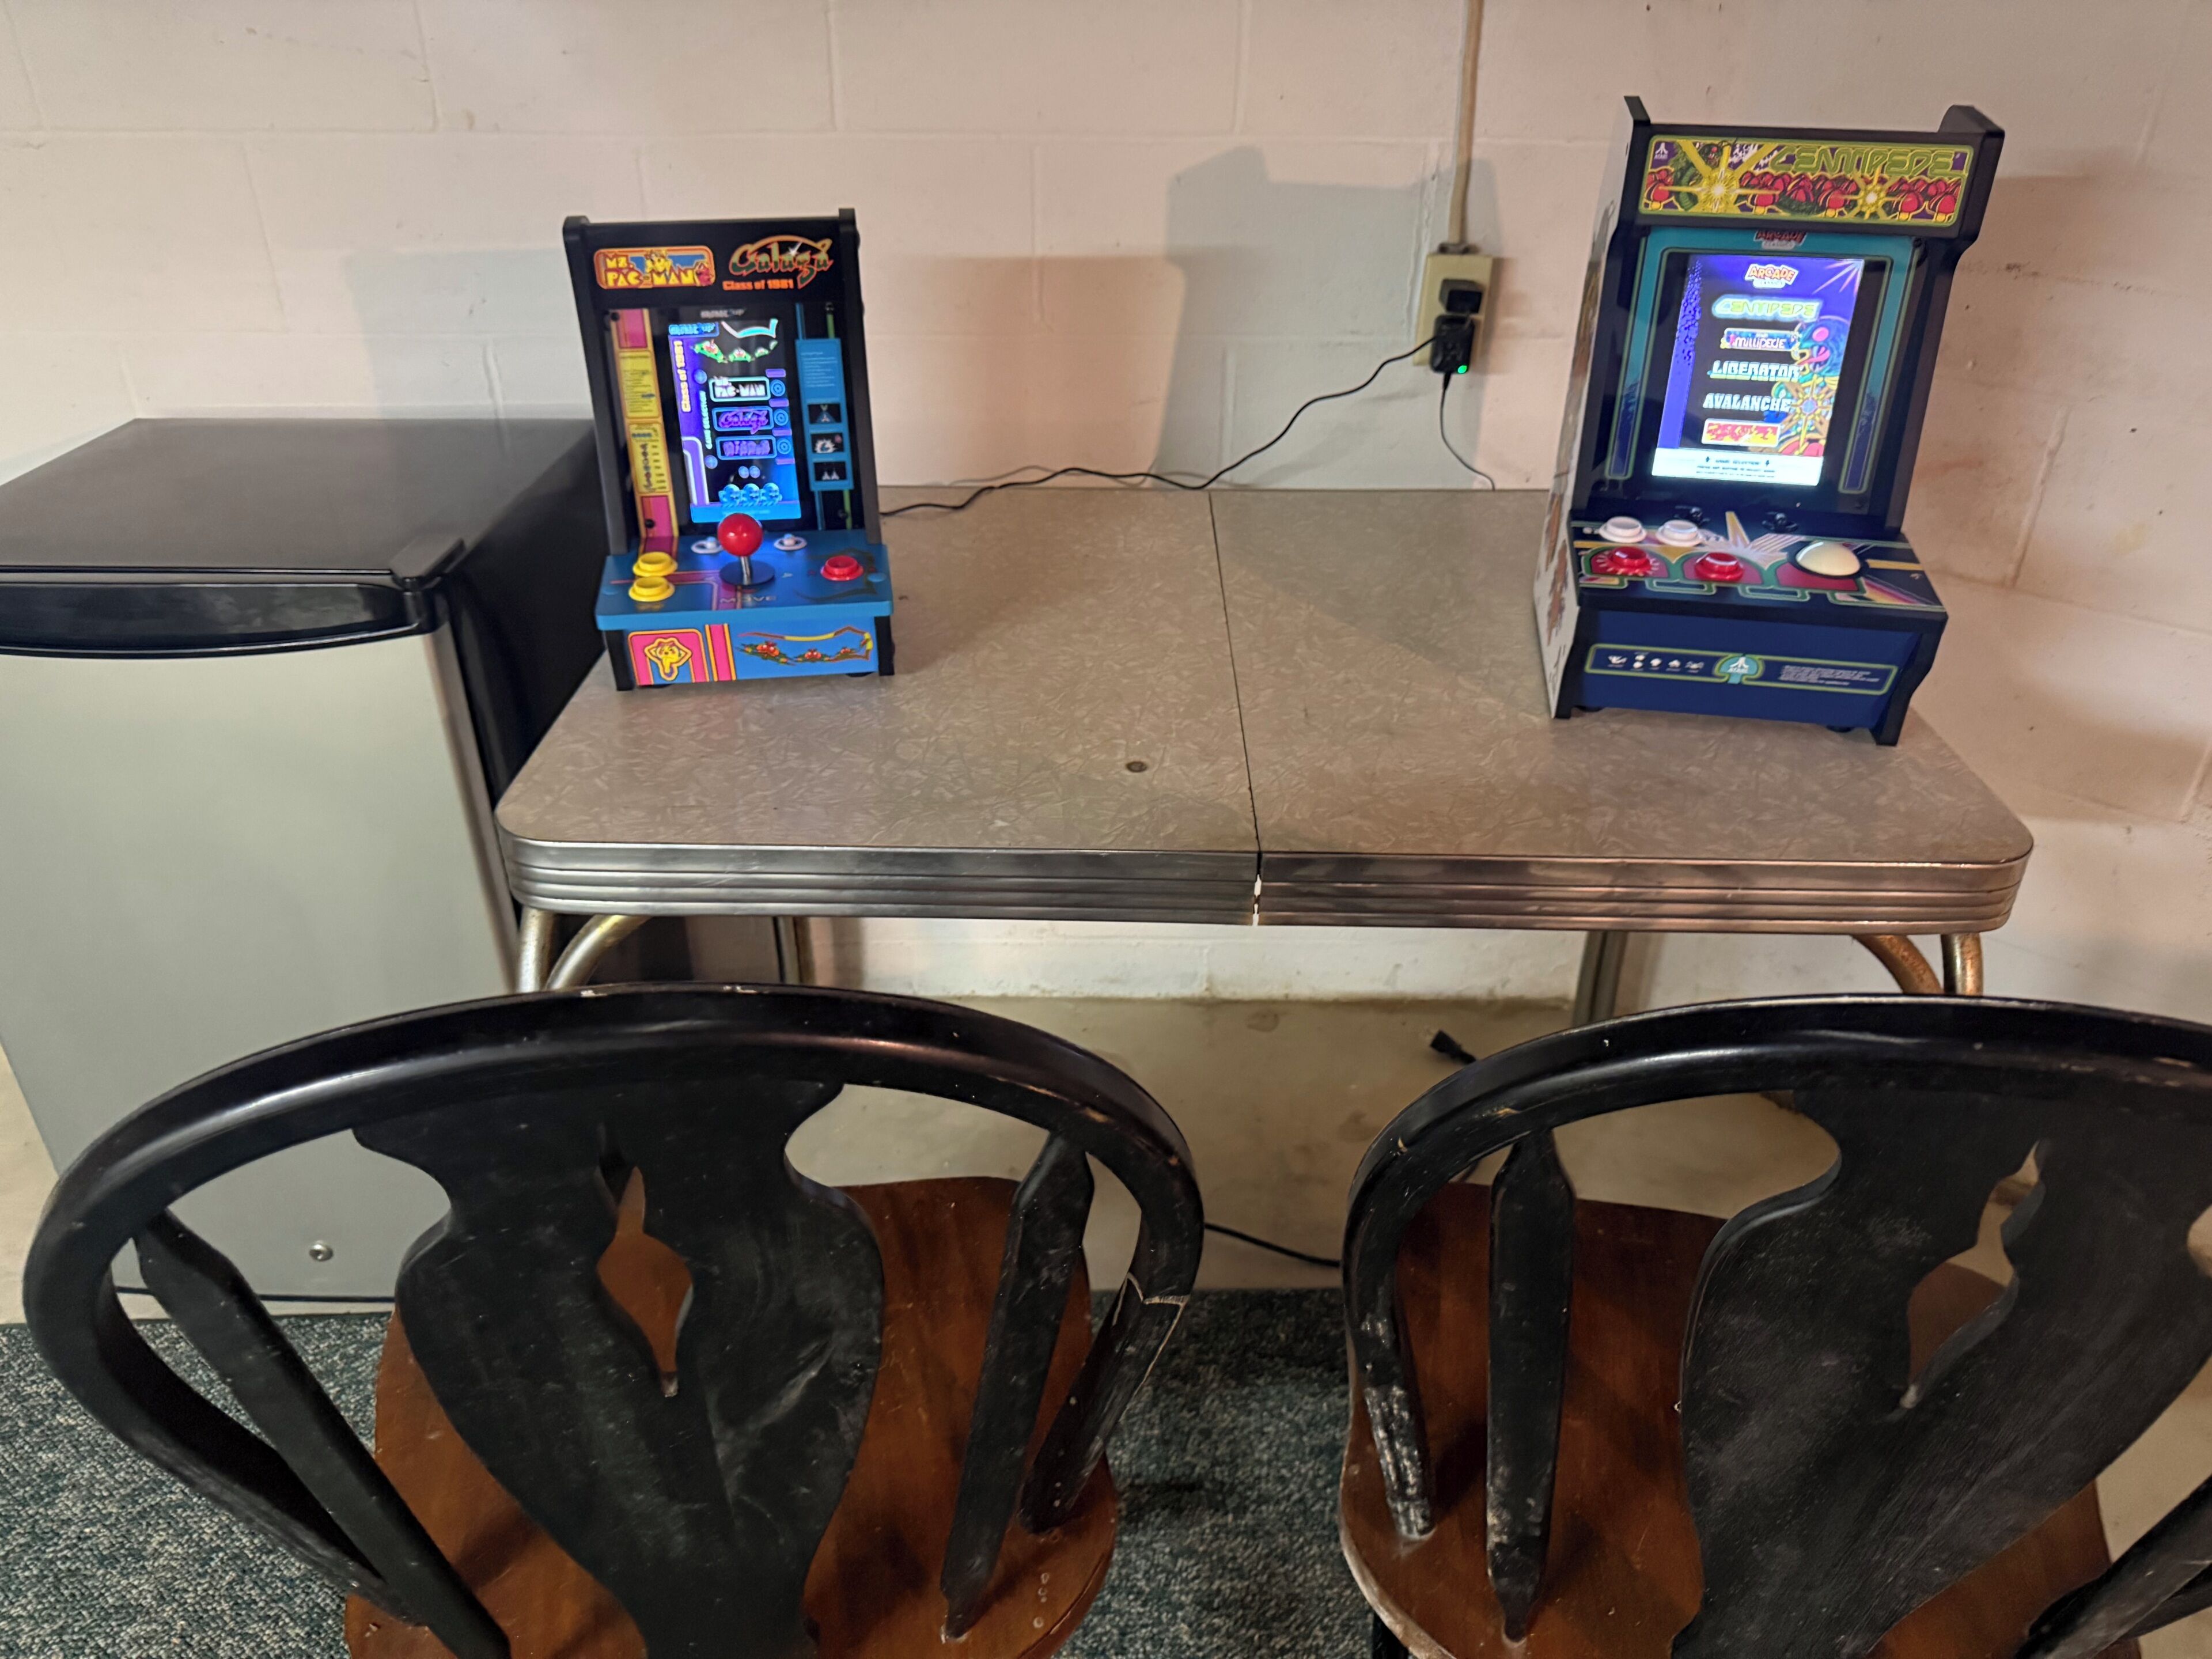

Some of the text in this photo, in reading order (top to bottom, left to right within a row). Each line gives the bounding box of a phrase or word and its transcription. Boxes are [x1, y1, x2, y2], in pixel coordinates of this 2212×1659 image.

[1769, 143, 1956, 175] CENTIPEDE
[605, 255, 633, 268] MS.
[605, 268, 696, 286] PAC-MAN
[1748, 266, 1796, 282] ARCADE
[754, 279, 765, 290] of
[1714, 297, 1819, 320] CENTIPEDE
[1703, 393, 1793, 412] AVALANCHE
